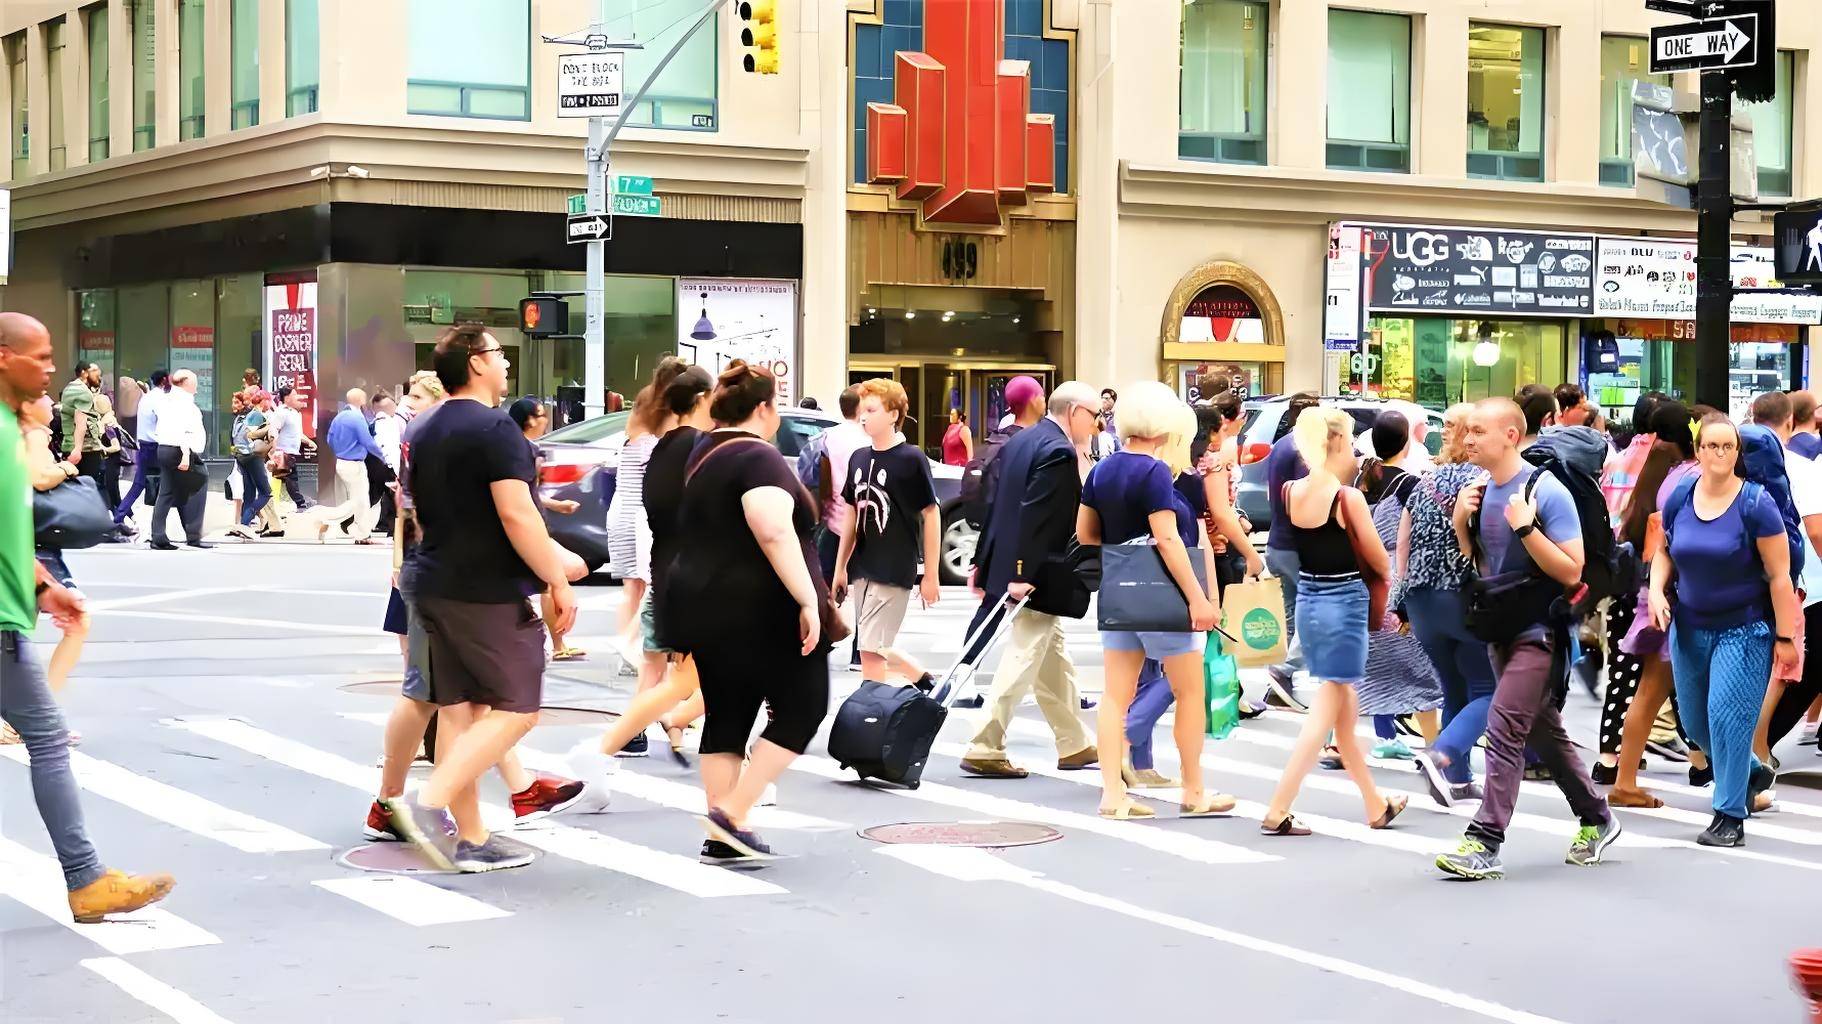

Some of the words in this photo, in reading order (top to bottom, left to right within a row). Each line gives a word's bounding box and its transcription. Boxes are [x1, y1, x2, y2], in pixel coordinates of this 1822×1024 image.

[1664, 37, 1693, 56] ONE
[1707, 32, 1738, 53] WAY
[621, 177, 632, 193] 7
[1393, 231, 1449, 266] UGG
